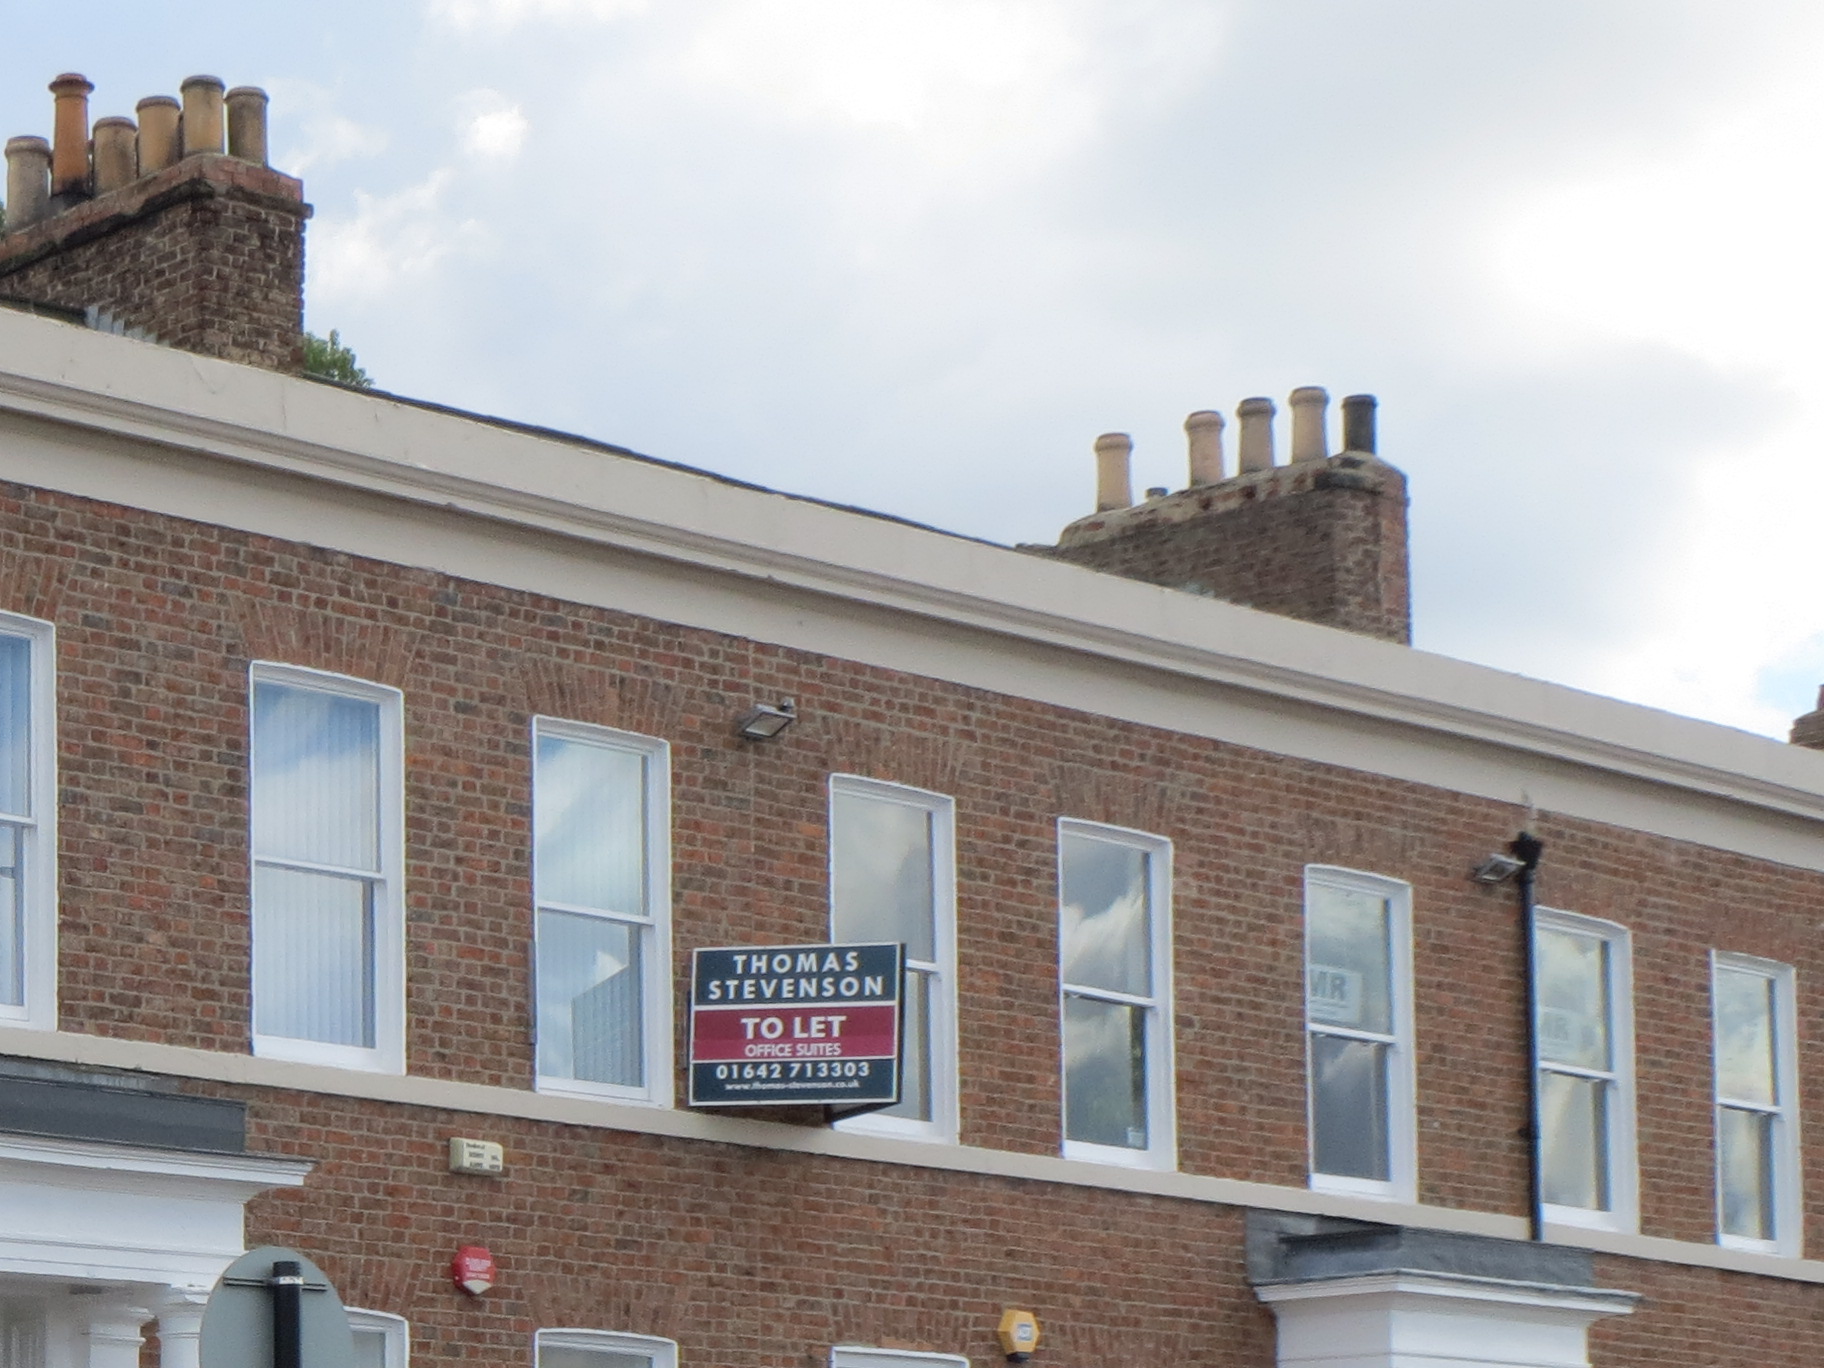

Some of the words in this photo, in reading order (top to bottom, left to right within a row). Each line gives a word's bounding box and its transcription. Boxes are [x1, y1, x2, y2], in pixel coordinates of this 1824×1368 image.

[733, 952, 858, 974] THOMAS
[708, 976, 884, 1000] STEVENSON
[740, 1017, 783, 1039] TO
[793, 1016, 847, 1038] LET
[744, 1044, 792, 1057] OFFICE
[796, 1043, 842, 1056] SUITES
[716, 1064, 782, 1080] 01642
[789, 1062, 870, 1078] 713303
